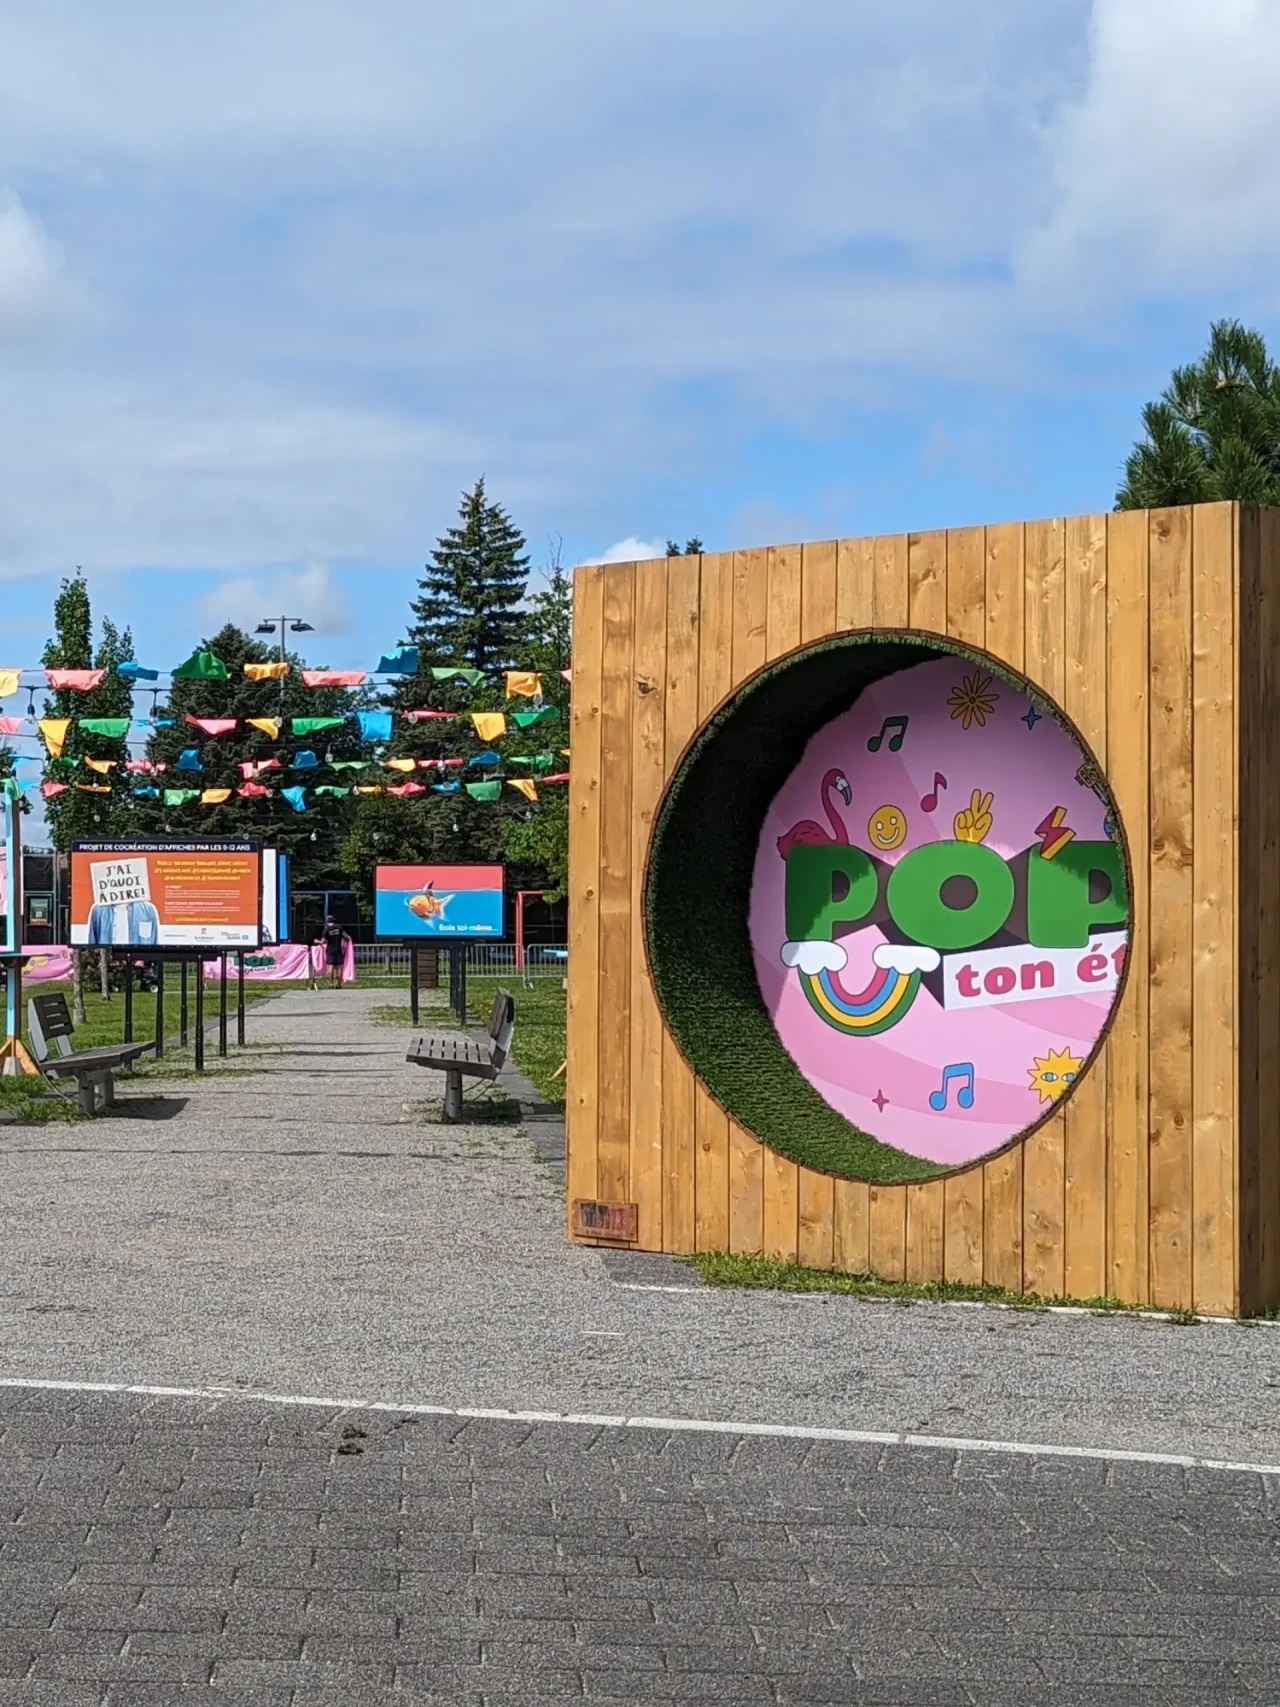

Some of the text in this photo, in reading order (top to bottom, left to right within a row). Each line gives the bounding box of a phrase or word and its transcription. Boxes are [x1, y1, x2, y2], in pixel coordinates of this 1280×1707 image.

[79, 843, 103, 851] PROJET
[114, 841, 157, 851] COCRÉATION
[105, 864, 132, 877] J'AI
[98, 875, 142, 890] D'QUOI
[99, 887, 145, 903] À DIRE!
[785, 840, 1128, 949] POP
[955, 960, 1055, 998] ton
